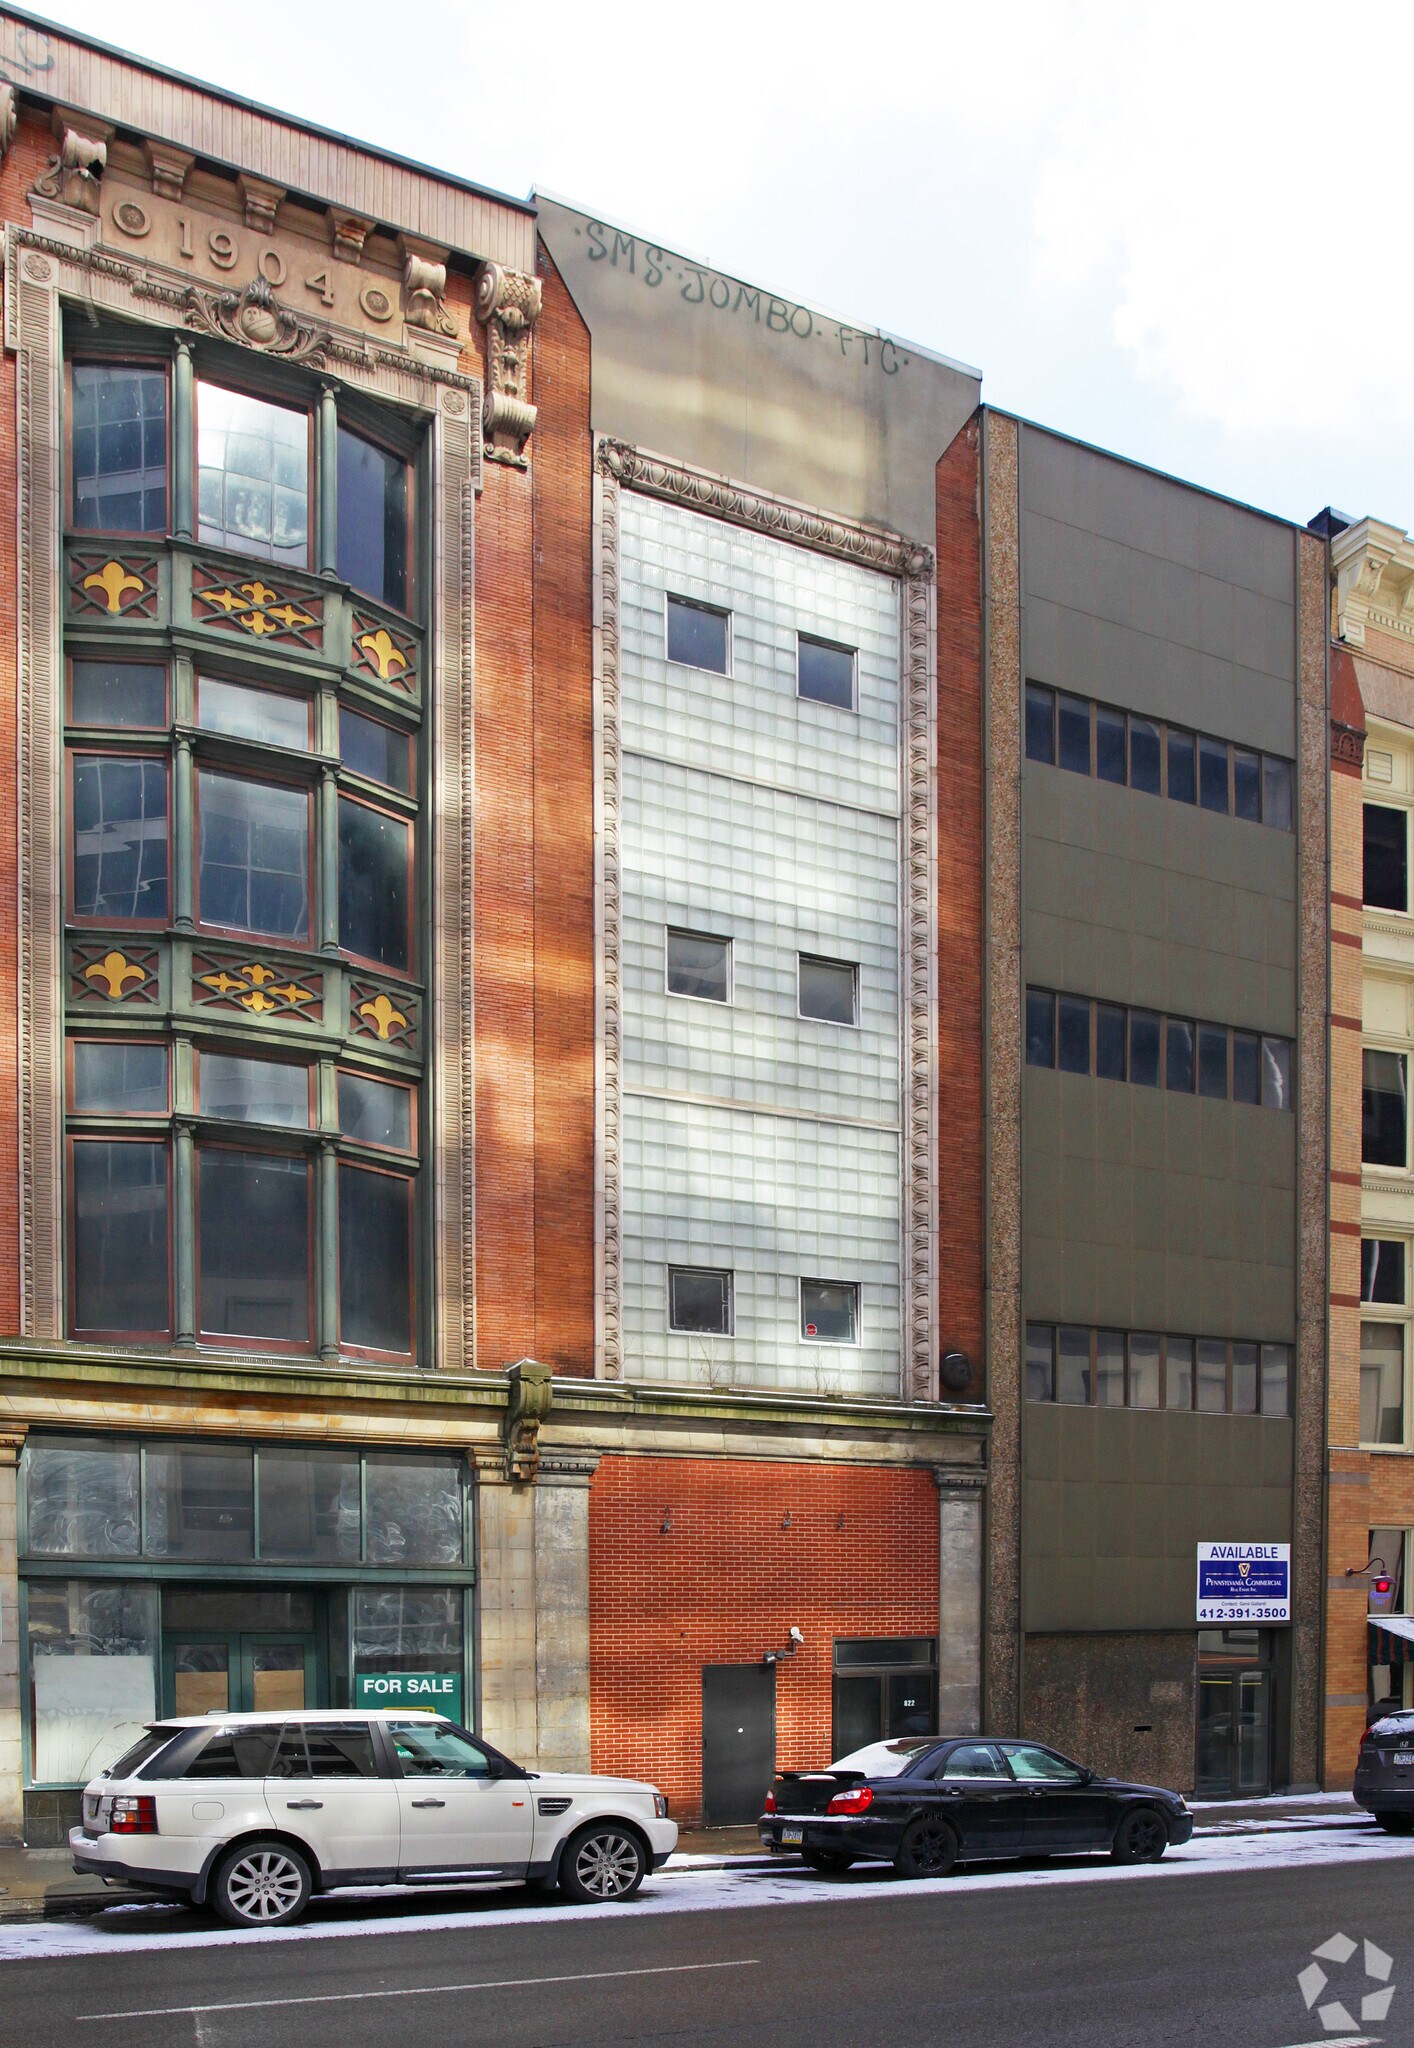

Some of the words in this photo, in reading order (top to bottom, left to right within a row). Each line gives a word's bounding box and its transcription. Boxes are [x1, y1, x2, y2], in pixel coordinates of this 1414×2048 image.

[586, 221, 664, 288] SMS
[177, 219, 335, 308] 1904
[1210, 1546, 1278, 1559] AVAILABLE
[1245, 1577, 1282, 1586] COMMERCIAL
[1200, 1608, 1287, 1618] 412-391-3500
[363, 1679, 402, 1694] FOR
[406, 1679, 454, 1693] SALE
